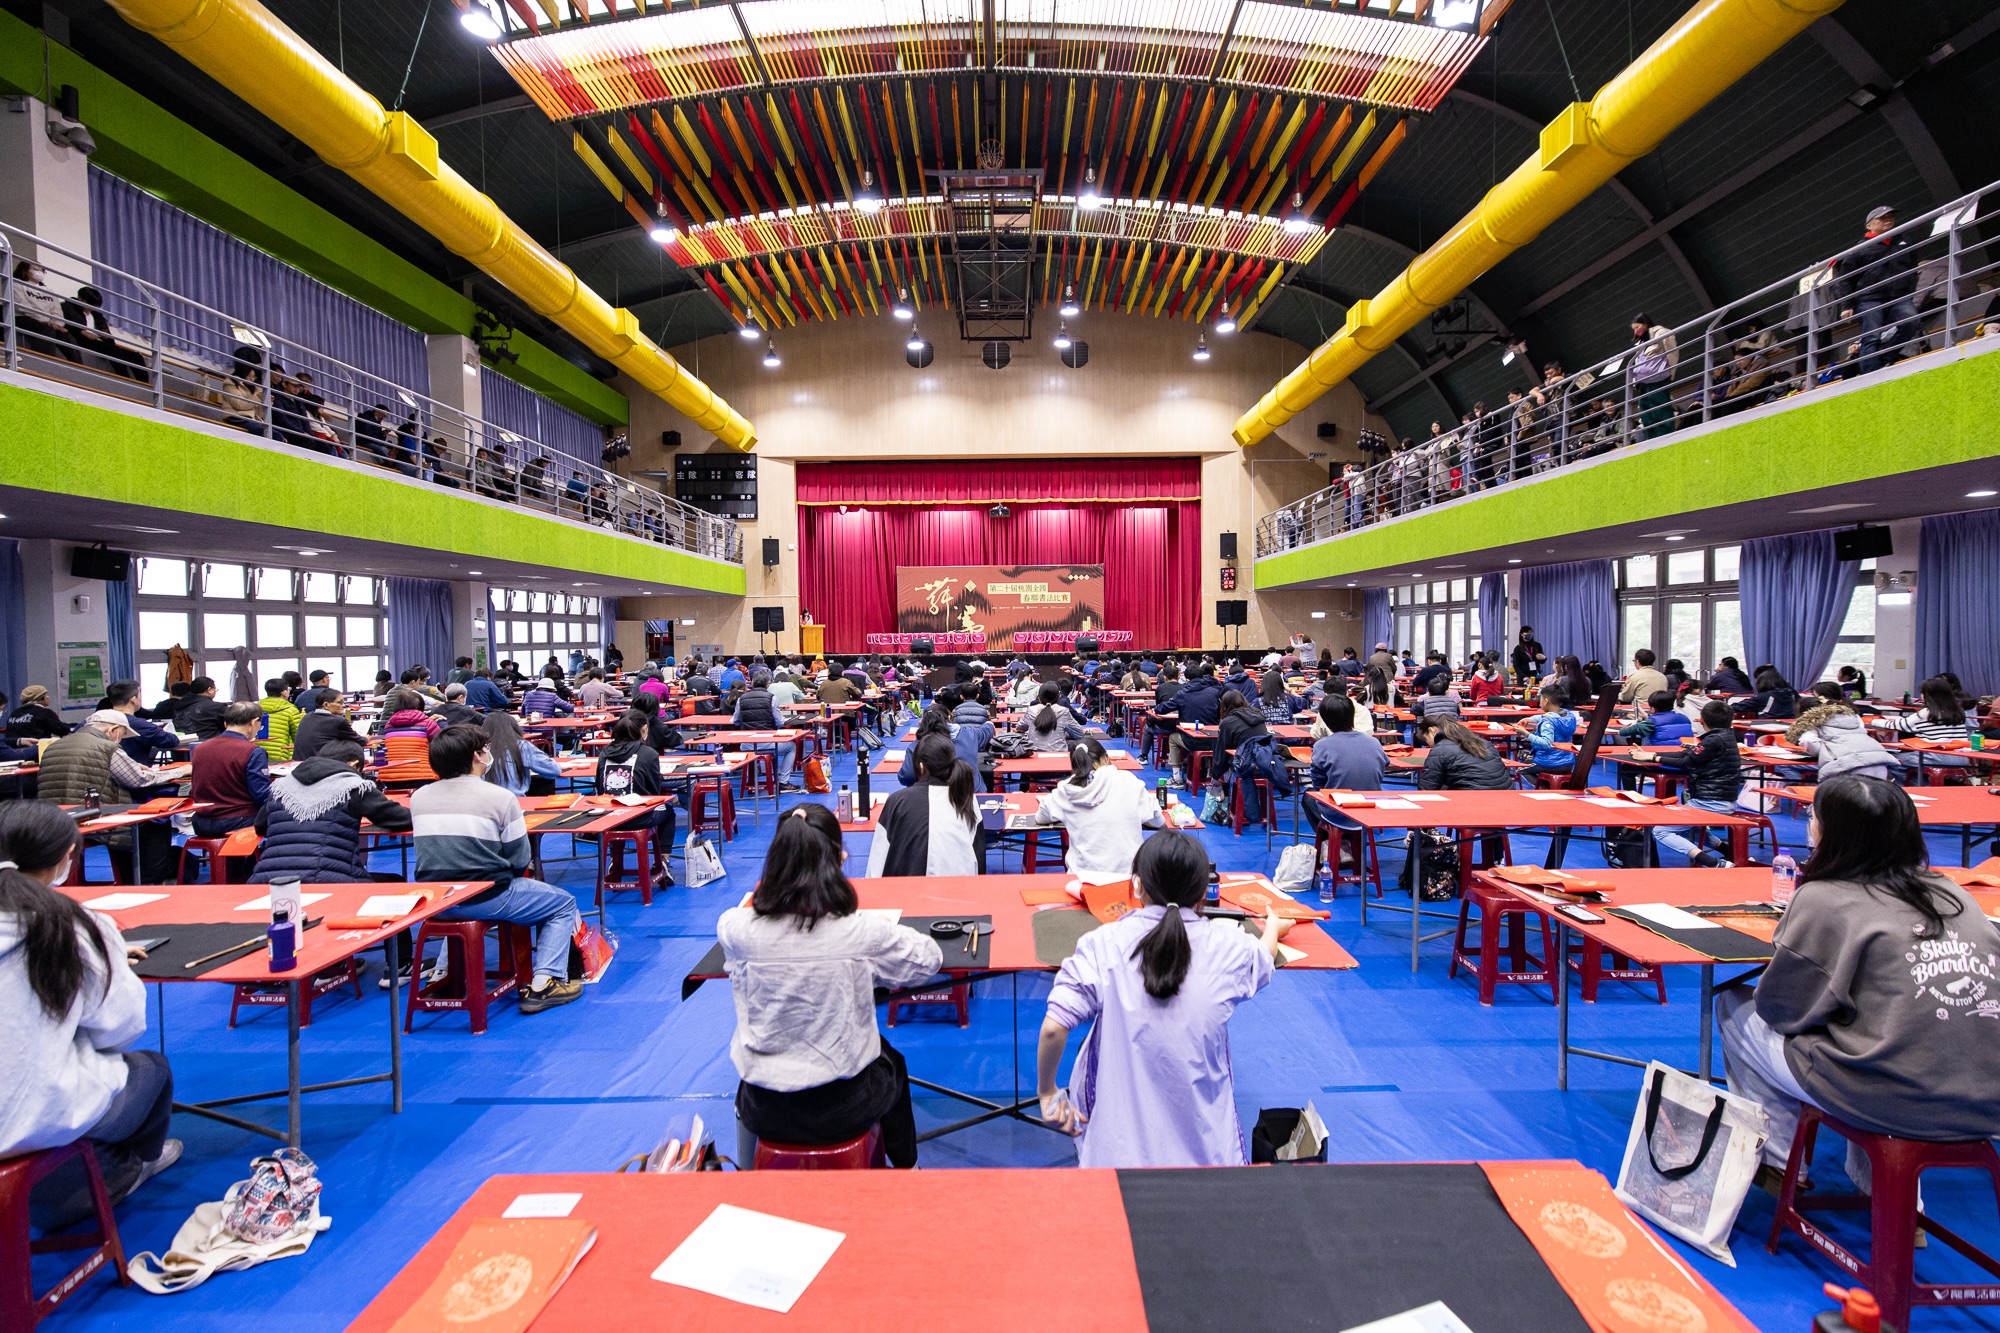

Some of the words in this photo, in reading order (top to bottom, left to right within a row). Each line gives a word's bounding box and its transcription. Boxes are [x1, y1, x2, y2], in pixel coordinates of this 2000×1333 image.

[677, 470, 697, 479] 主隊
[735, 470, 756, 479] 客隊
[989, 584, 1047, 592] 第二十屆桃園全國
[1023, 593, 1069, 602] 春聯書法比賽
[1920, 939, 1973, 962] Skate
[1928, 986, 1955, 1006] NEVER
[1955, 996, 1973, 1007] STOP
[1973, 984, 1988, 1002] RIDE
